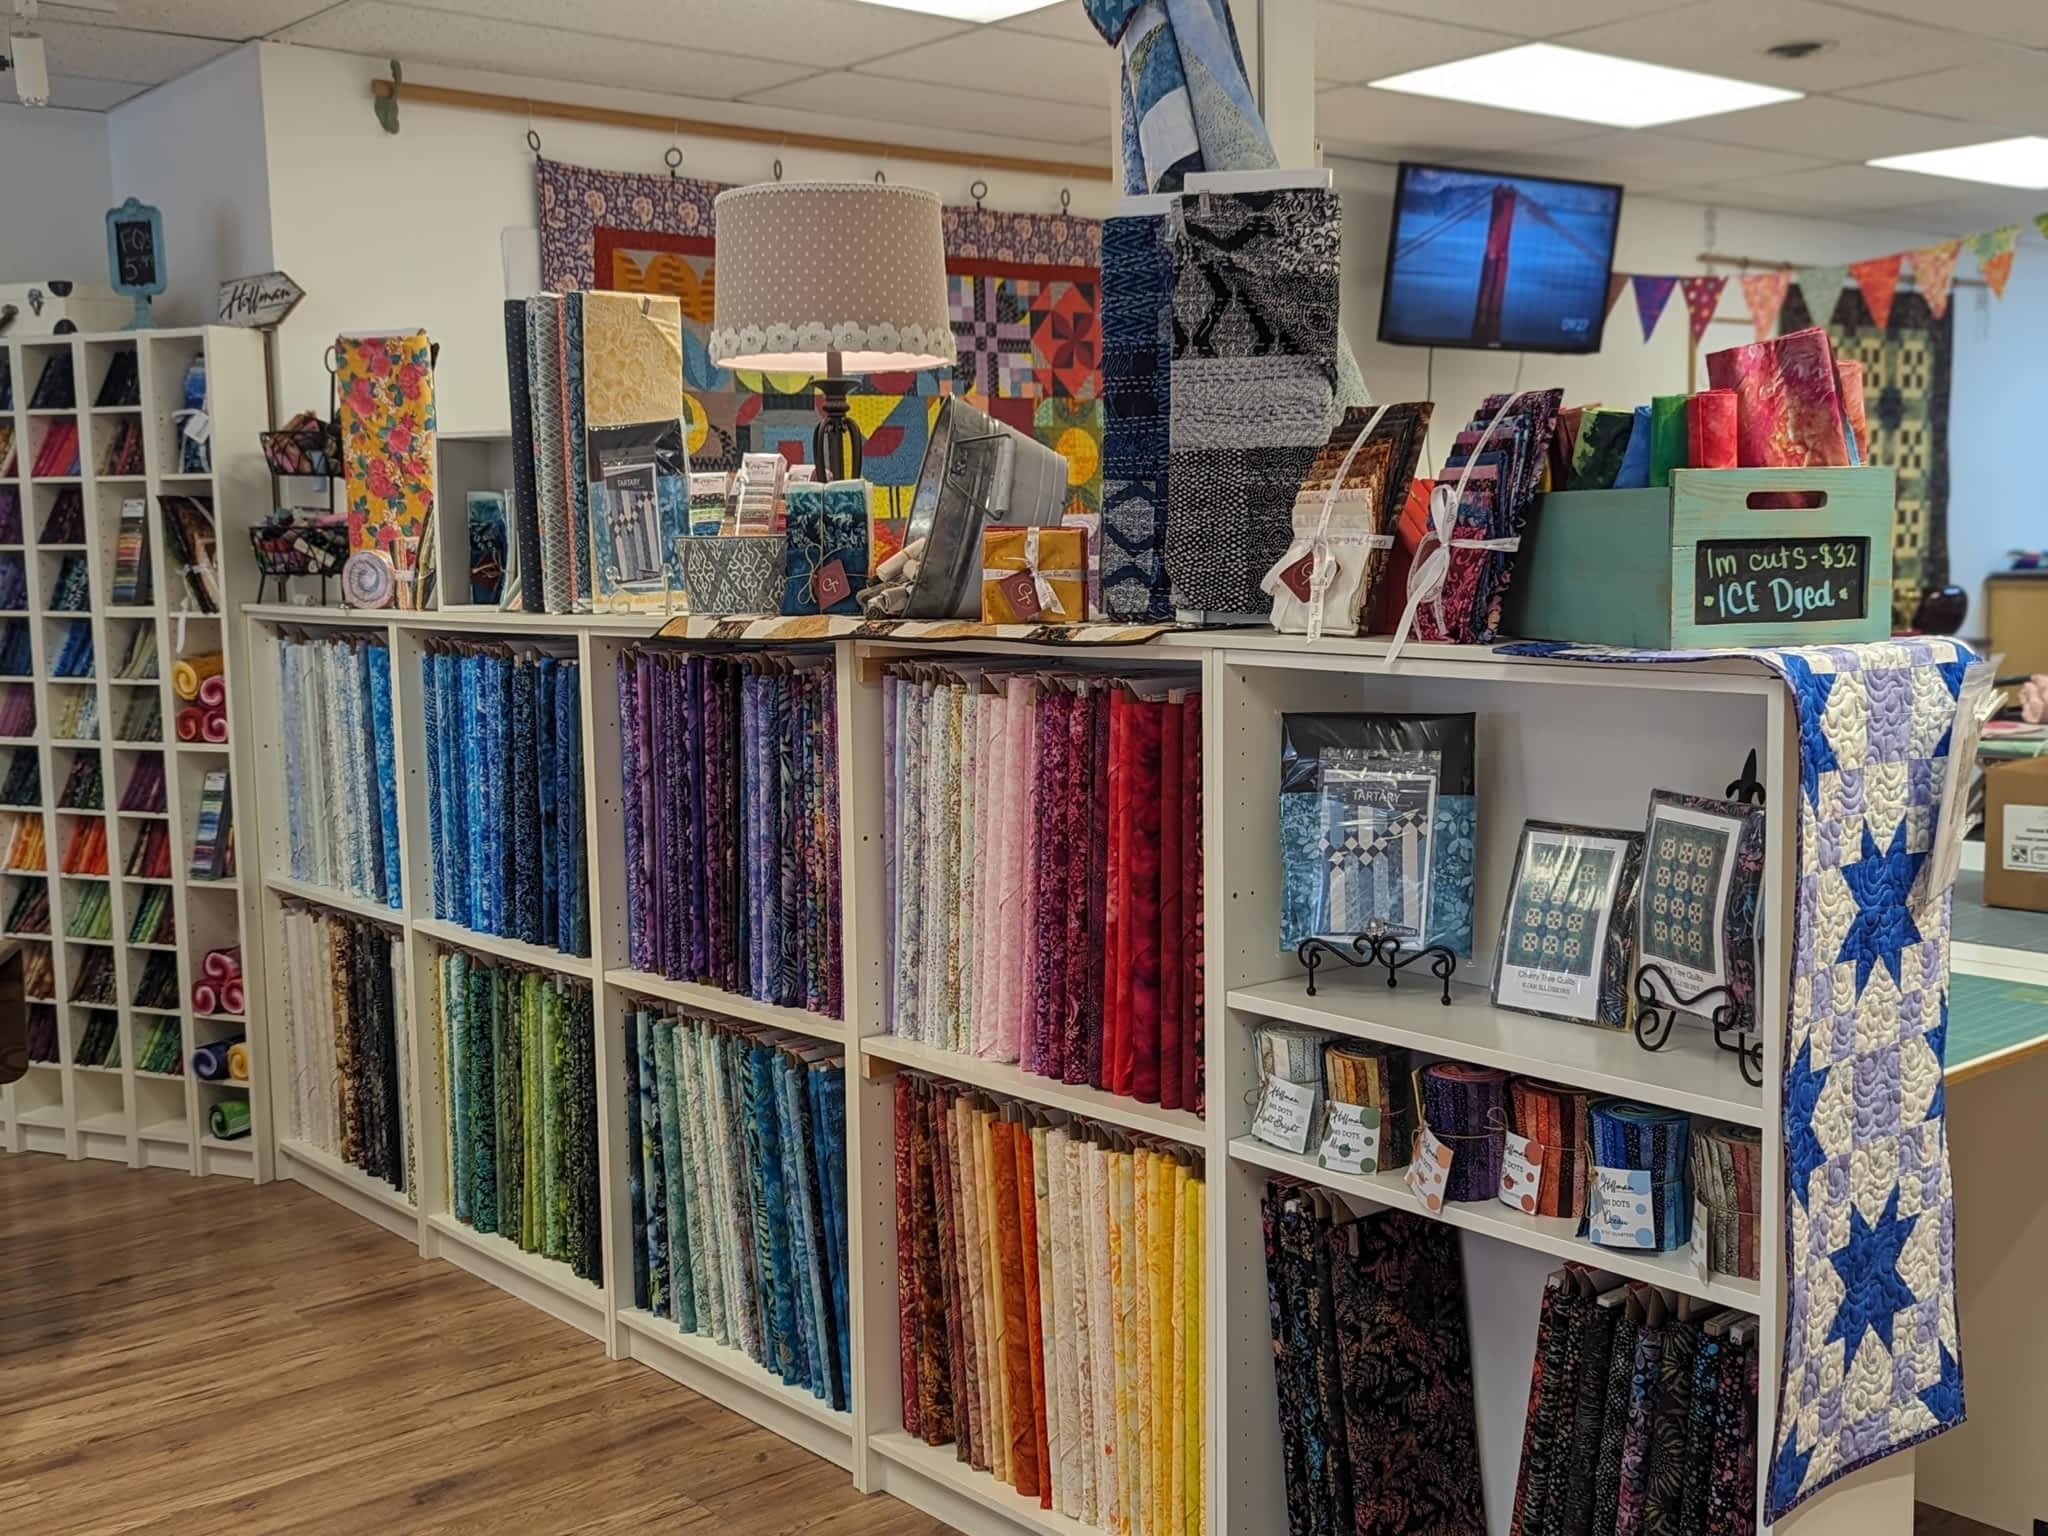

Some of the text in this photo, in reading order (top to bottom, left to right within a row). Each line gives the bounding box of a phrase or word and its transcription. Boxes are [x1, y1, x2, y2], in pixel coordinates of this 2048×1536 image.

[1768, 577, 1836, 619] Dyed
[1352, 788, 1401, 803] TARTARY
[1600, 1178, 1635, 1193] Hoffman
[1611, 1199, 1631, 1209] DOTS
